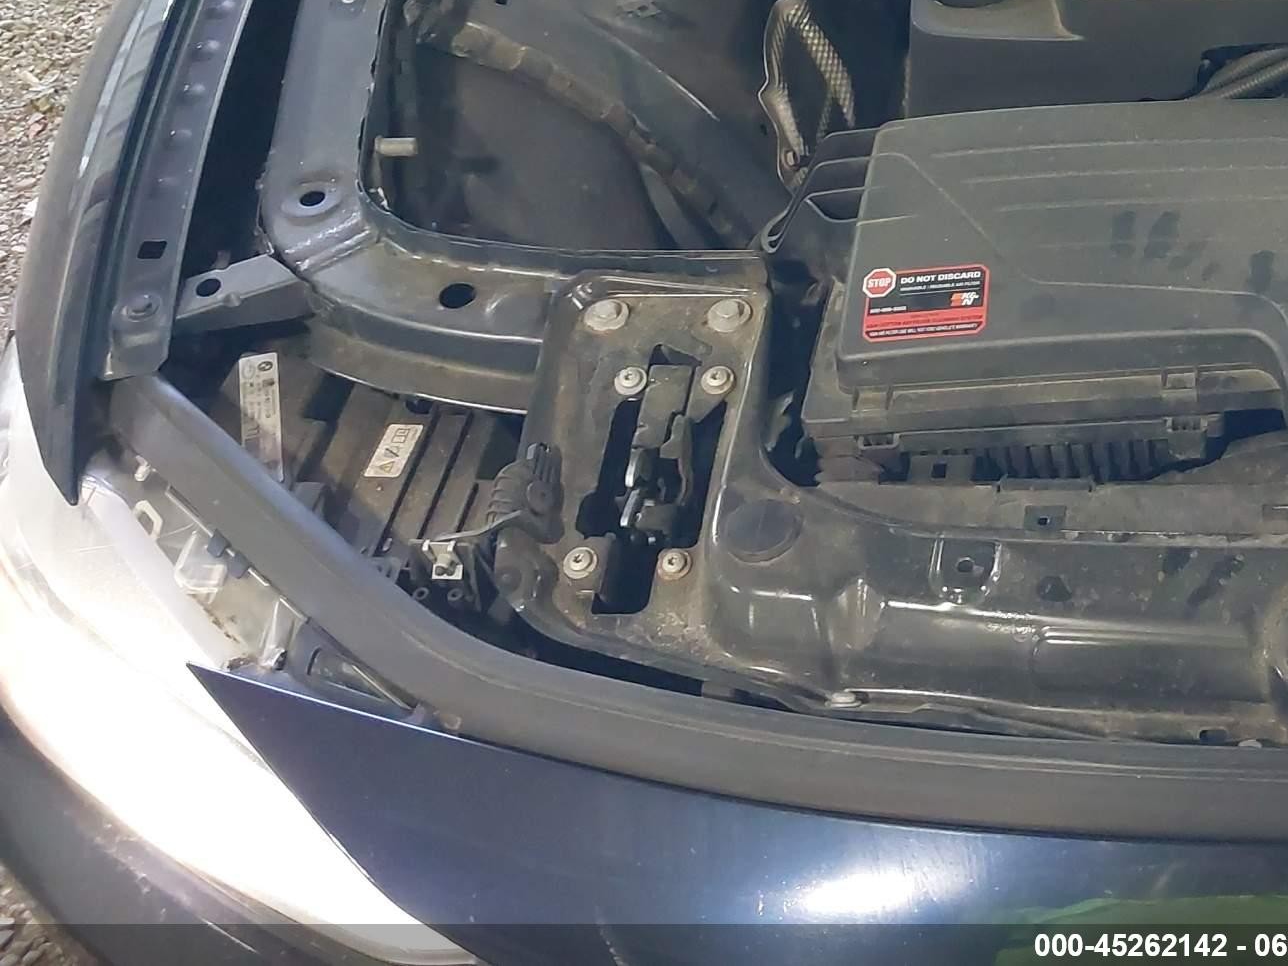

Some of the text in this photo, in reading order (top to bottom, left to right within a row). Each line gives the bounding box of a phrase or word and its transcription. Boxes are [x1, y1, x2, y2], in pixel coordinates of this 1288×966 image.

[867, 277, 892, 289] STOP
[916, 275, 937, 283] NOT
[937, 271, 981, 281] DISCARD
